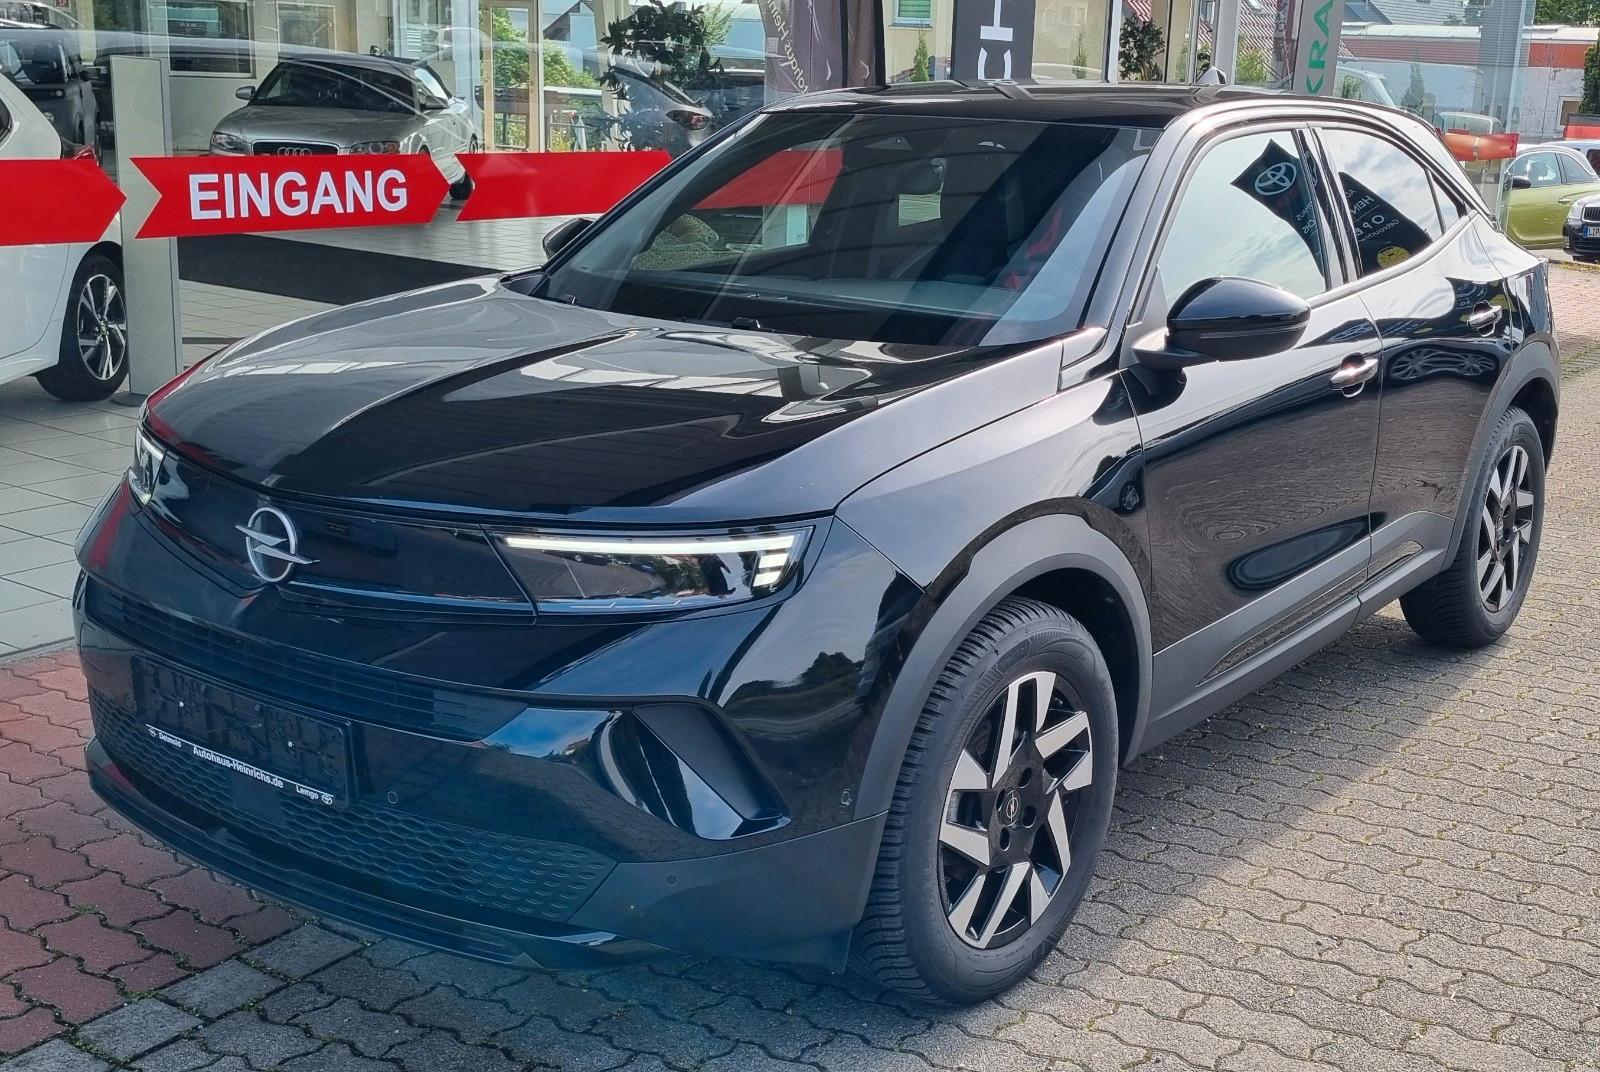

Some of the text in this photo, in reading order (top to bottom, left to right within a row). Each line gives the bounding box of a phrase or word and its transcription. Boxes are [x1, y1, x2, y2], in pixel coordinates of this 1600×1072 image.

[188, 169, 408, 221] EINGANG
[158, 732, 320, 801] Detmold Autohaus-Heinrichs.de Lemgo
